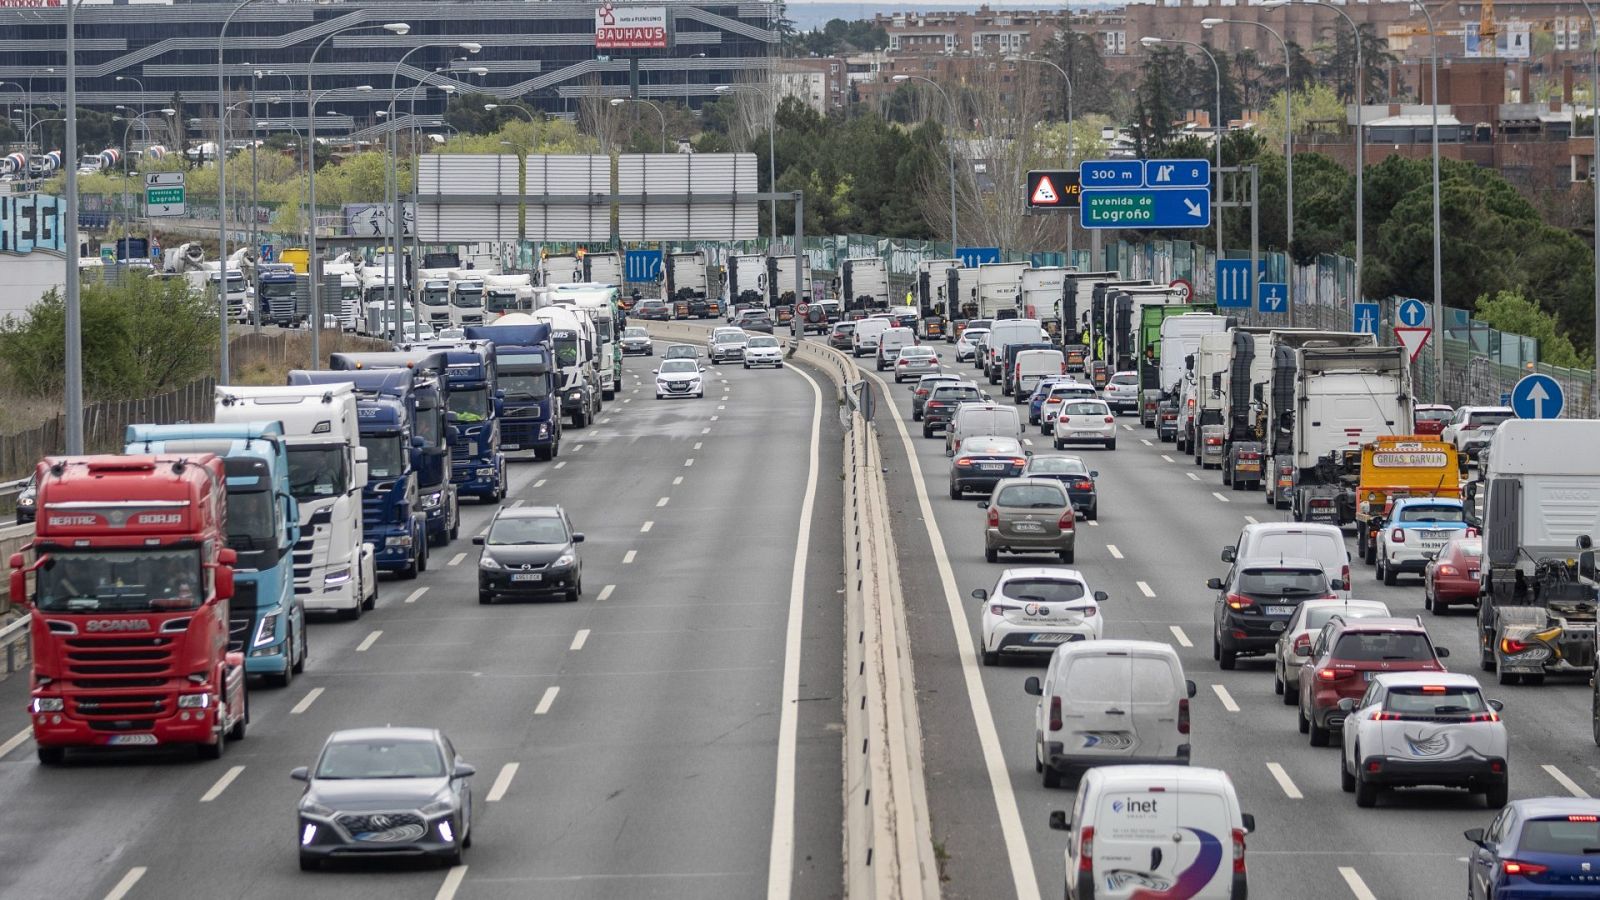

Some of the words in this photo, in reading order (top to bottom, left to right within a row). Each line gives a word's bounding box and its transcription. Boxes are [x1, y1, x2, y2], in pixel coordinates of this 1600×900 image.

[598, 27, 663, 39] BAUHAUS
[1092, 170, 1116, 179] 300
[1122, 171, 1132, 179] m
[1192, 169, 1199, 177] 8
[1092, 197, 1133, 206] avenida
[1140, 196, 1152, 206] de
[1093, 208, 1151, 222] Logroño
[1377, 455, 1405, 464] GRUAS
[49, 516, 95, 525] BEATRIZ
[138, 514, 181, 524] BORJA
[86, 618, 150, 633] SCANIA
[1125, 797, 1155, 813] inet
